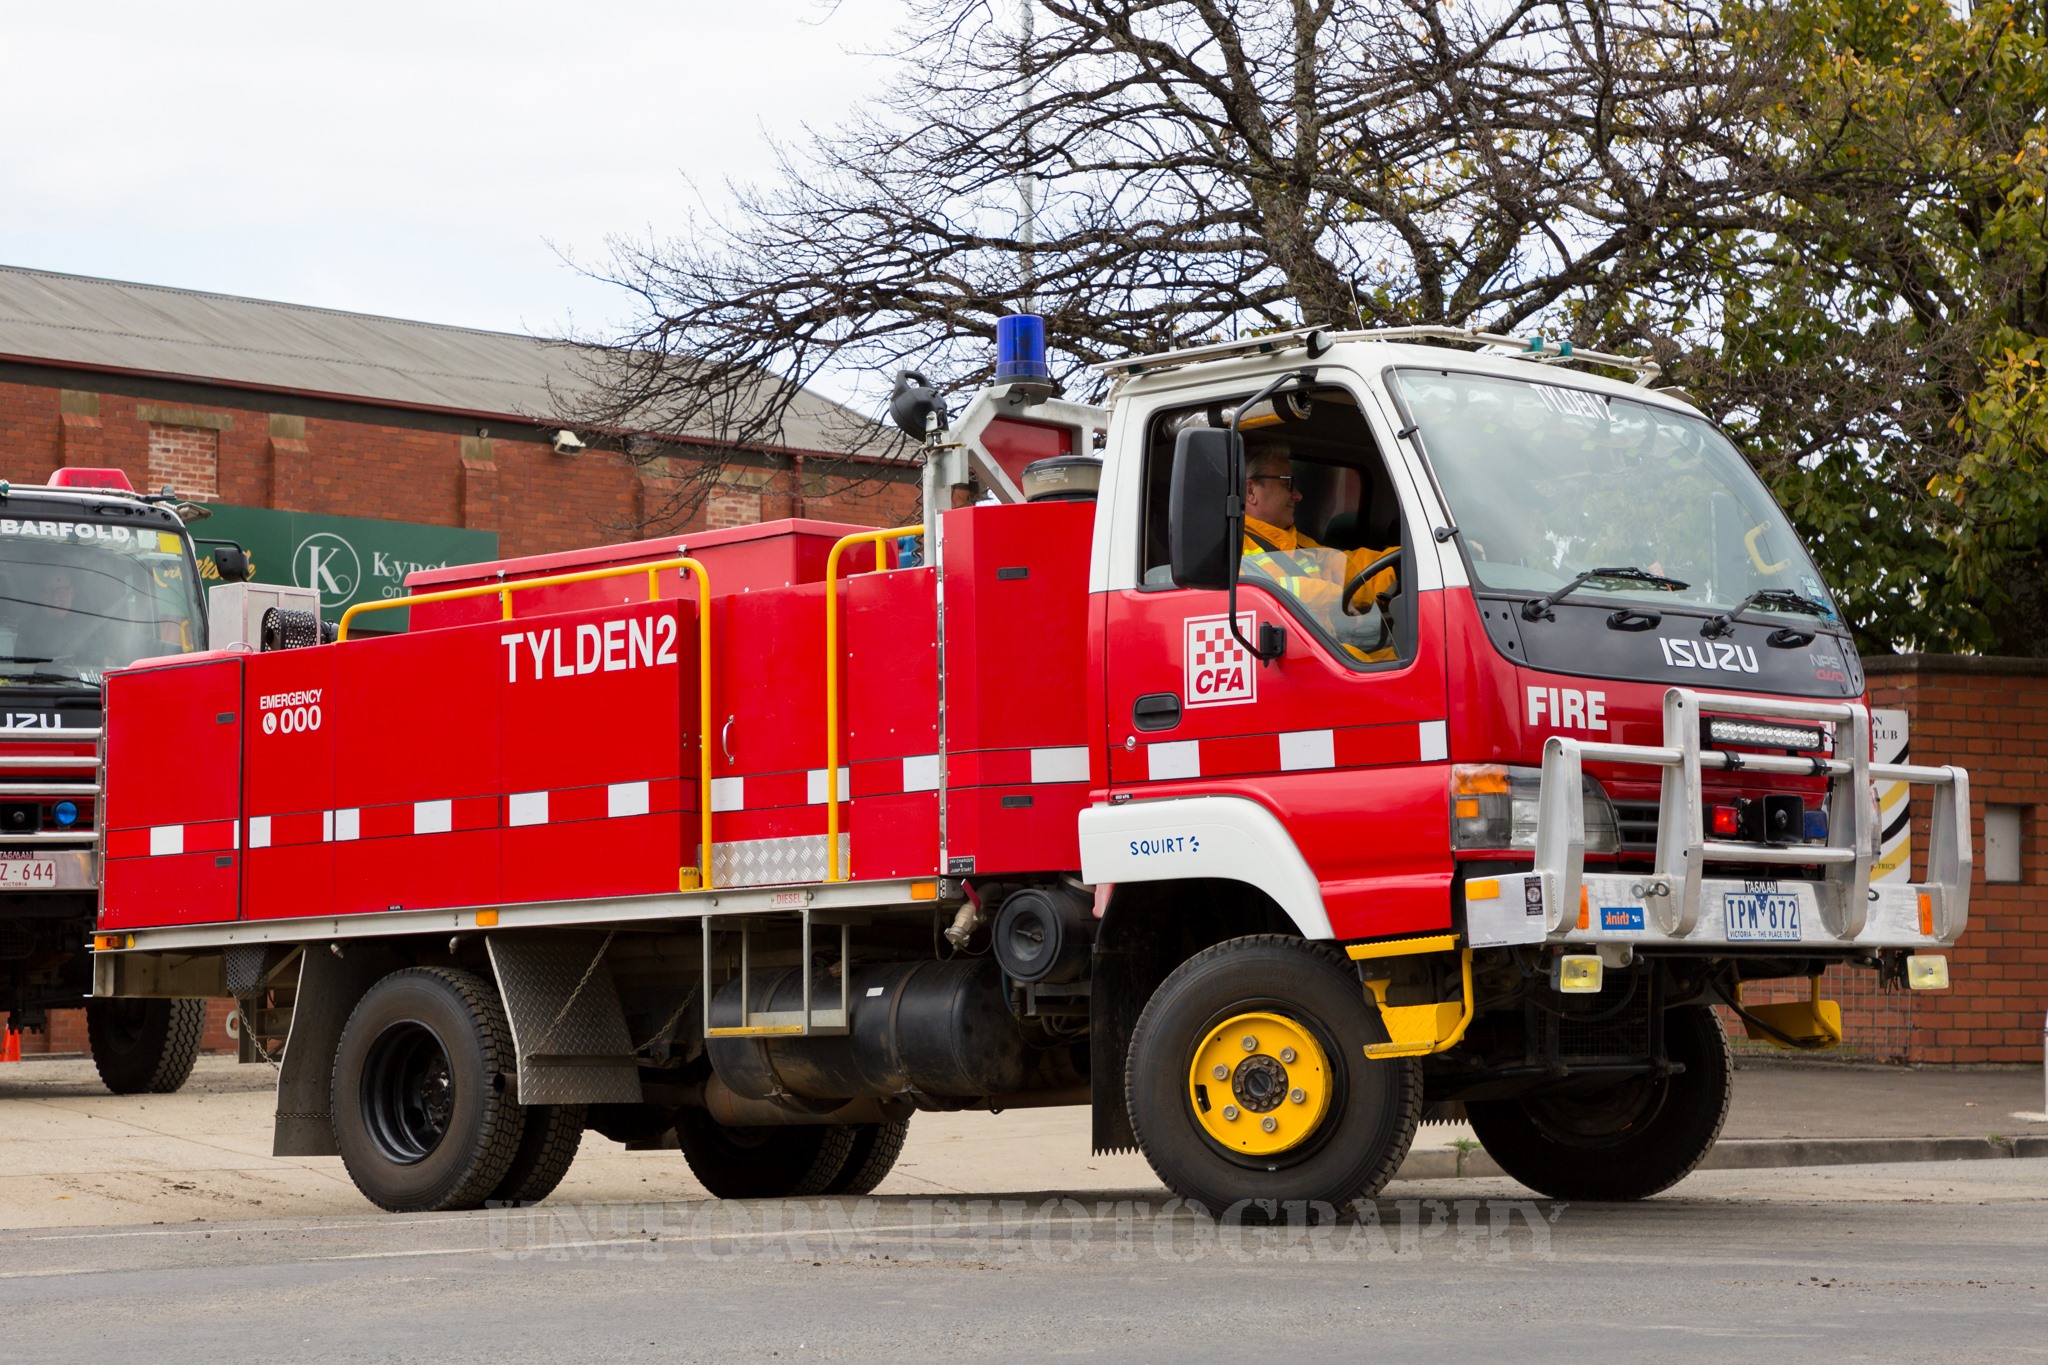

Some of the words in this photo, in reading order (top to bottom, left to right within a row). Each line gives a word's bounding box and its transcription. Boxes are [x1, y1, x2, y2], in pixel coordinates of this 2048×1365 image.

[1529, 383, 1606, 421] TYLDEN
[0, 519, 130, 542] BARFOLD
[501, 614, 677, 683] TYLDEN2
[1659, 637, 1759, 674] ISUZU
[1809, 653, 1841, 670] NPS
[1195, 666, 1245, 695] CFA
[259, 688, 322, 710] EMERGENCY
[1527, 686, 1607, 731] FIRE
[280, 705, 322, 734] 000
[1130, 836, 1184, 856] SQUIRT
[776, 893, 801, 904] DIESEL
[1745, 880, 1778, 894] TASMAN
[1727, 899, 1758, 929] TPM
[1768, 899, 1797, 929] 872
[1730, 930, 1752, 938] VICTORIA
[1758, 930, 1767, 938] THE
[1769, 930, 1782, 938] PLACE
[1784, 930, 1791, 938] TO
[1792, 930, 1798, 938] BE
